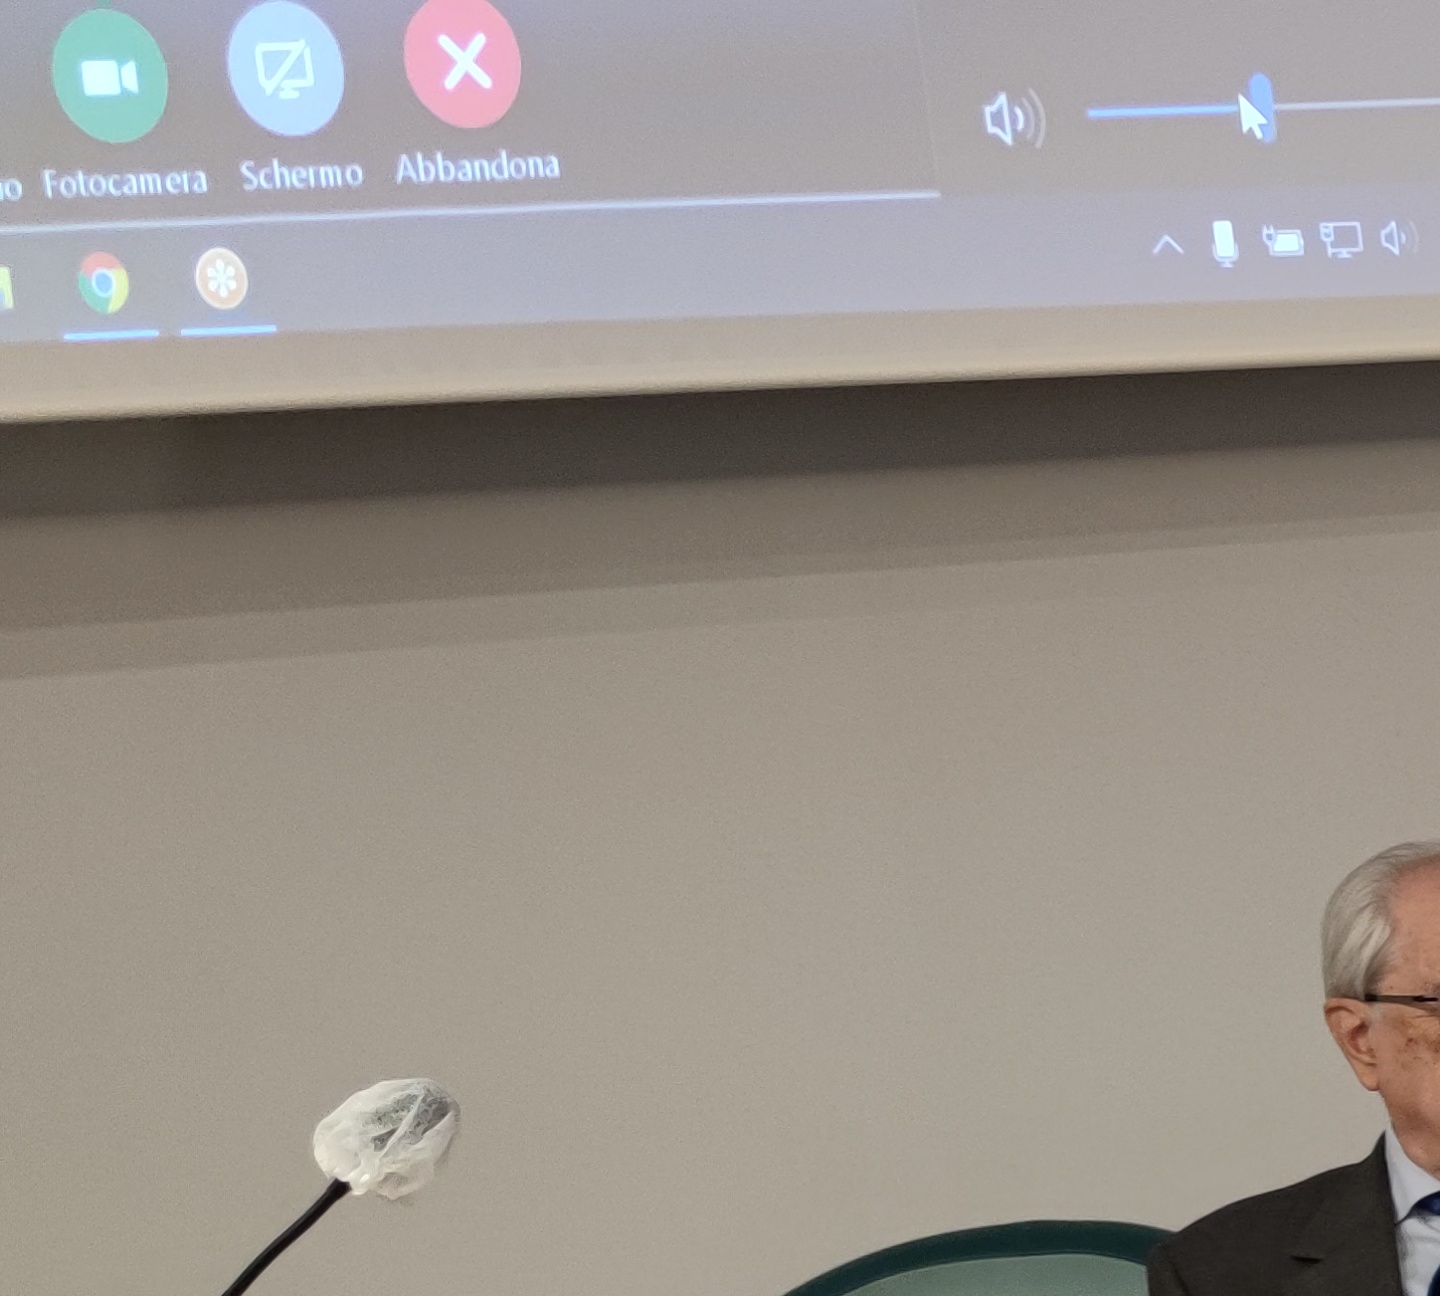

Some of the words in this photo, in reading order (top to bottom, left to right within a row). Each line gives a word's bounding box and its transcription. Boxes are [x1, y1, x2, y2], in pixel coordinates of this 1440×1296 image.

[240, 158, 364, 191] Schermo
[397, 149, 560, 184] Abbandona
[43, 168, 208, 199] Fotocamera
